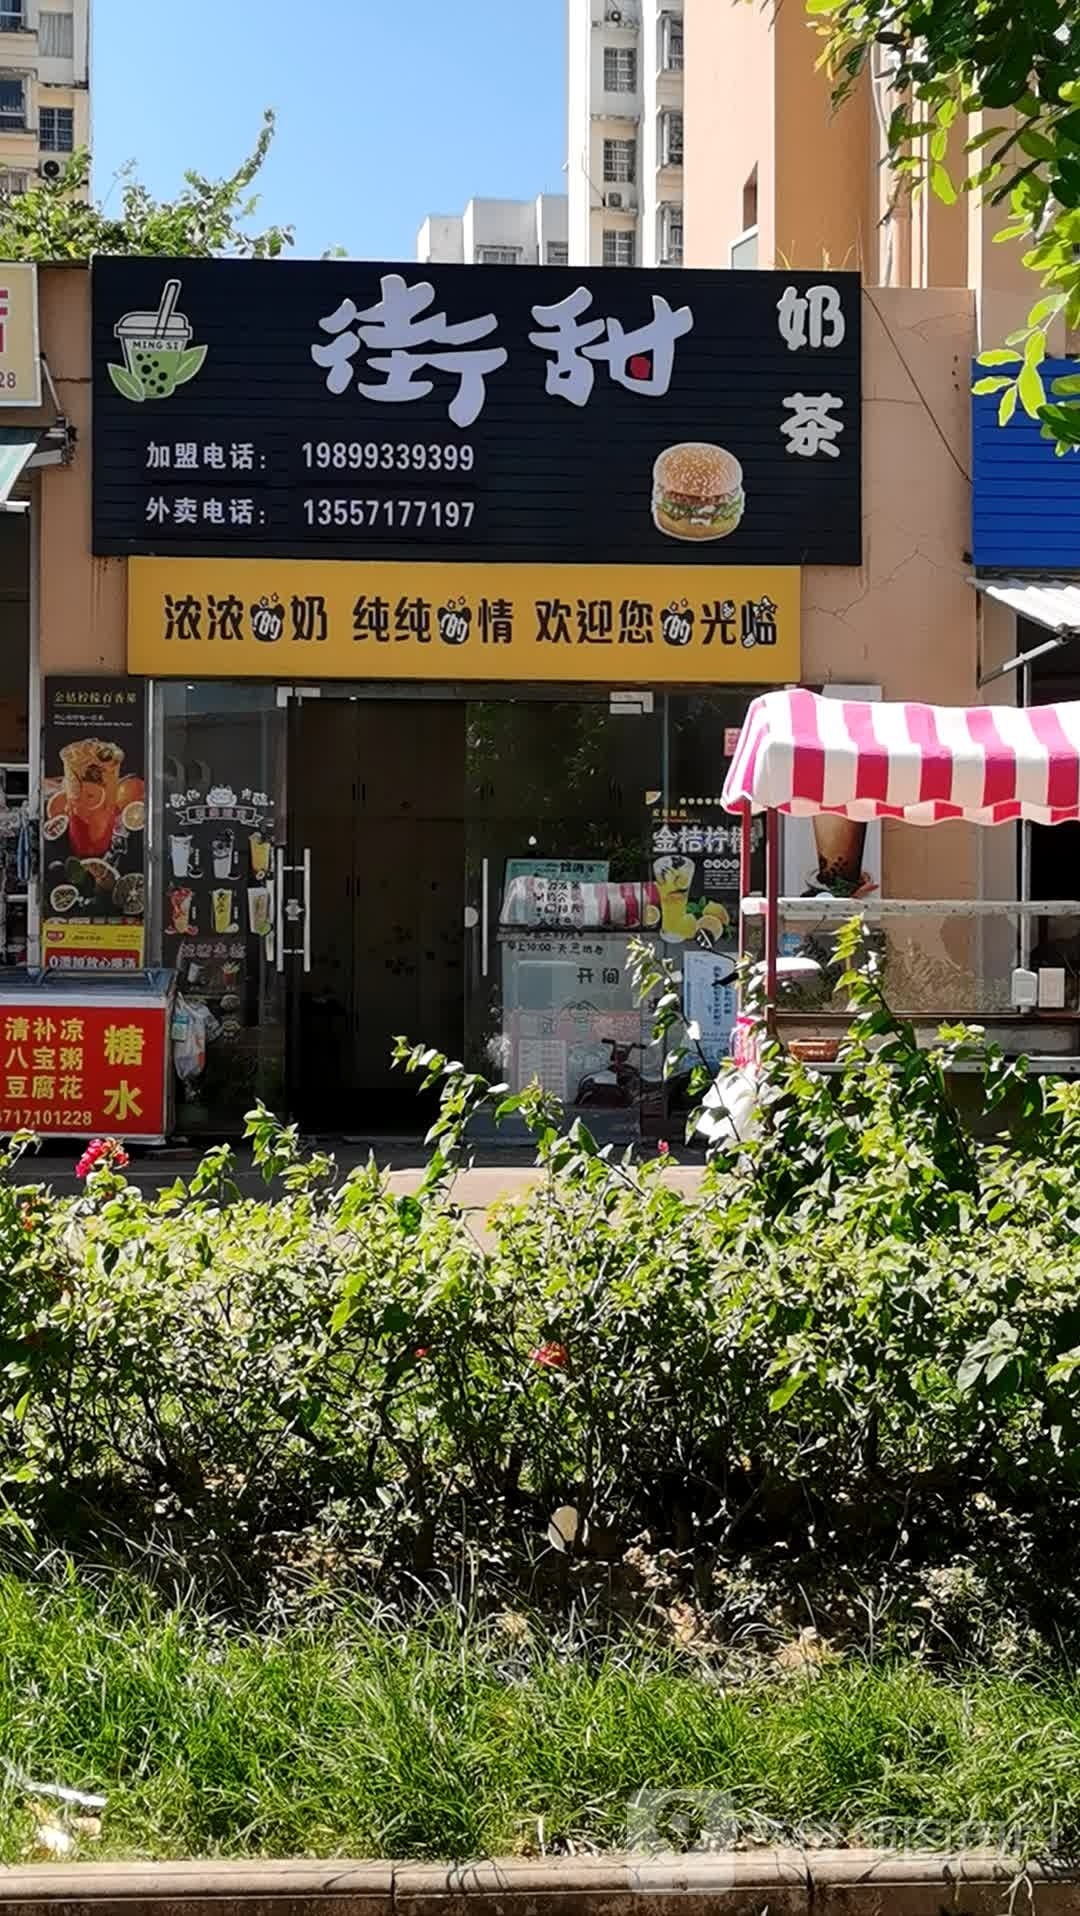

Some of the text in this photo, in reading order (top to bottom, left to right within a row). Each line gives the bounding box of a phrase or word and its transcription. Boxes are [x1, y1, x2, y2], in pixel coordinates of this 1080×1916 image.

[132, 341, 179, 350] MING SI
[311, 274, 694, 428] 街甜
[777, 285, 845, 457] 奶茶
[145, 442, 474, 471] 加盟电话： 19899339399
[145, 498, 475, 528] 外卖电话： 13557177197
[164, 593, 329, 643] 浓浓的奶
[352, 595, 514, 645] 纯纯的情
[5, 1016, 85, 1042] 清补凉
[5, 1046, 84, 1071] 八宝粥
[103, 1024, 145, 1121] 糖水
[5, 1075, 84, 1100] 豆腐花
